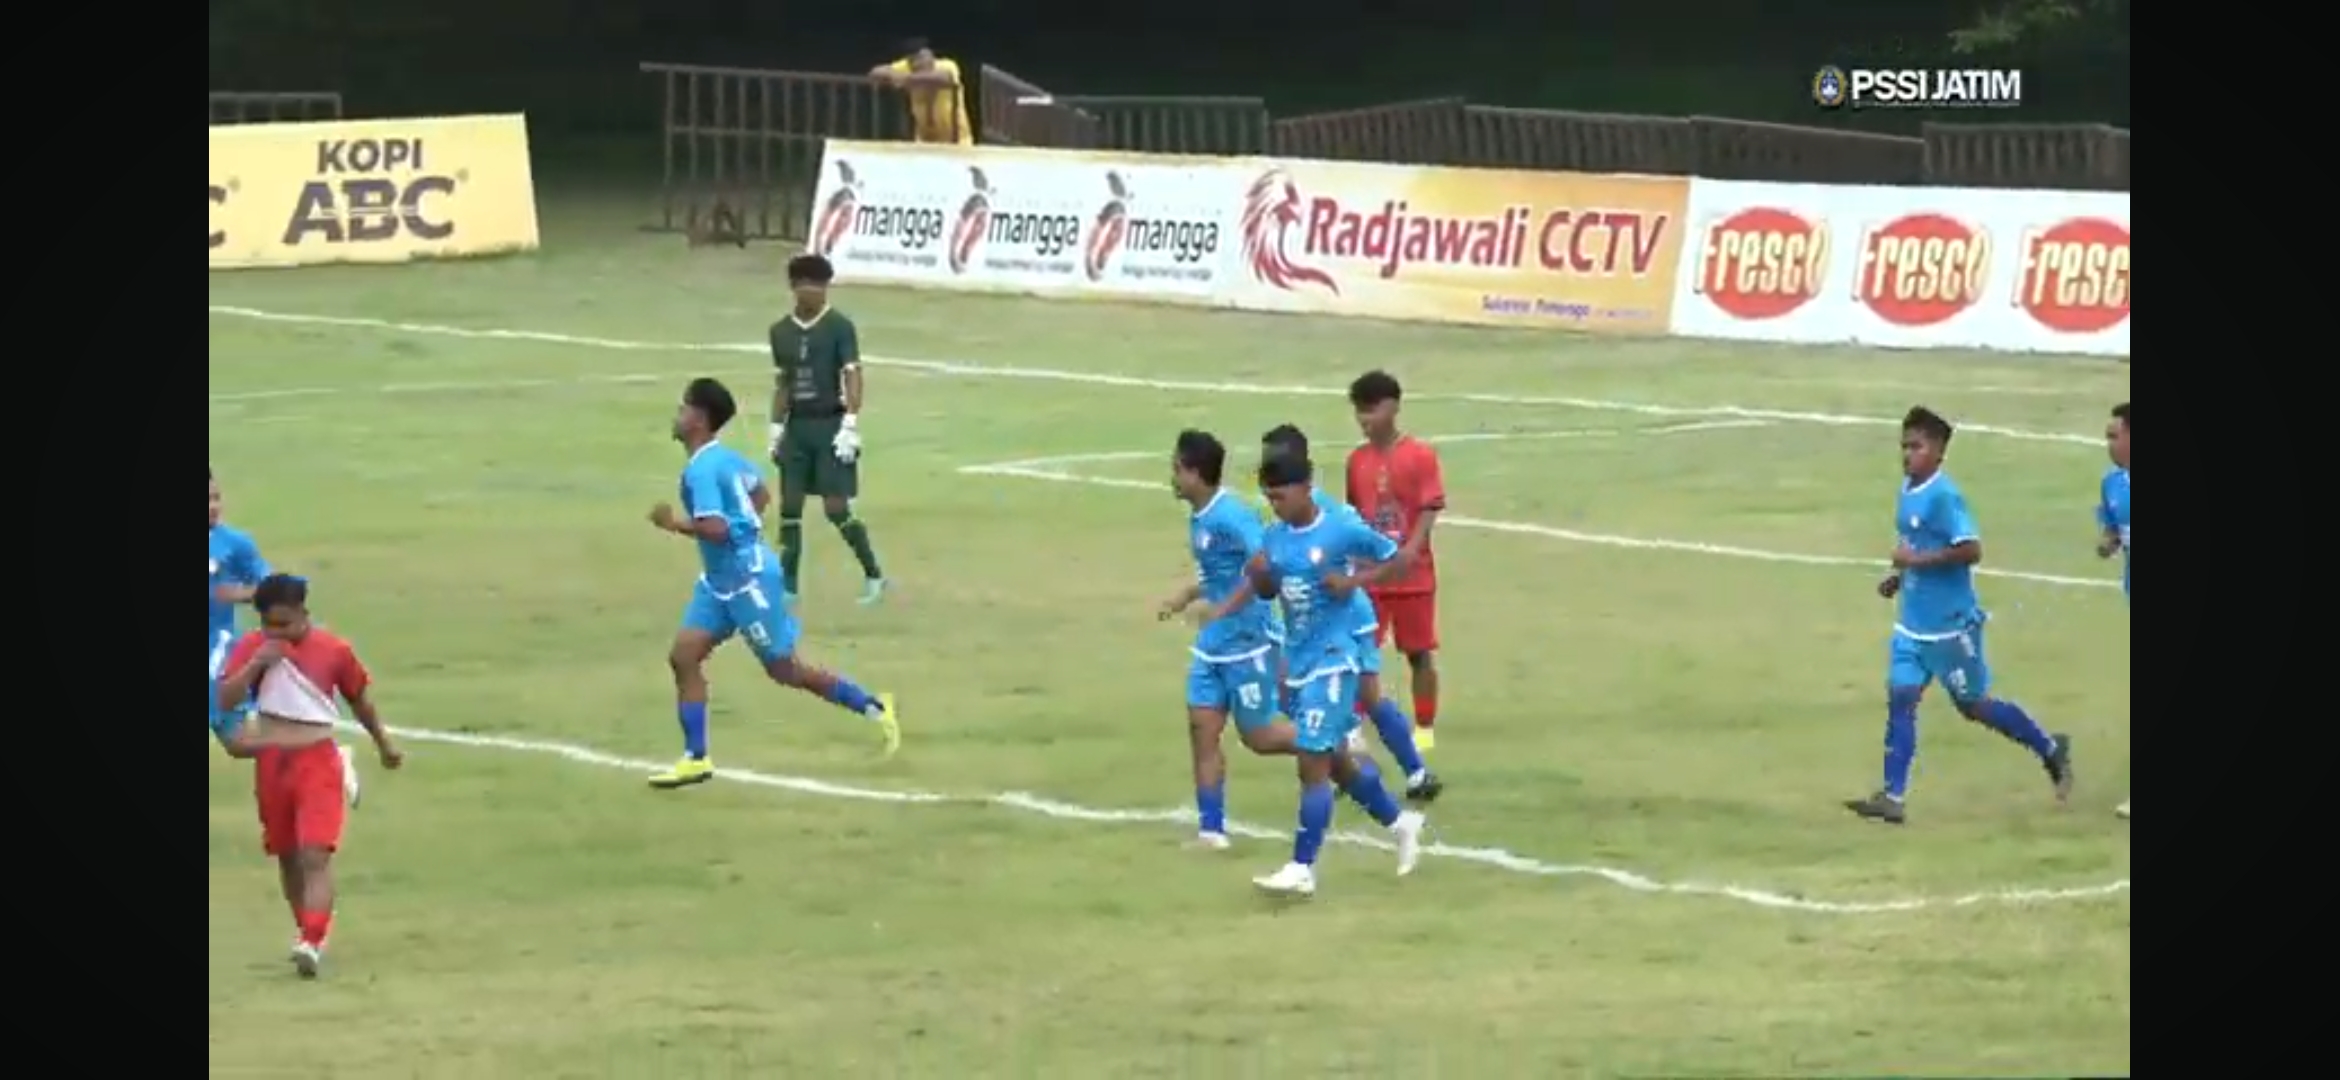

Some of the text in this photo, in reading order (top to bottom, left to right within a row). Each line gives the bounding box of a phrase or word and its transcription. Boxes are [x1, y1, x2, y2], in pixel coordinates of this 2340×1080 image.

[317, 138, 423, 173] KOPI
[282, 175, 455, 245] ABC
[854, 205, 944, 248] mangga
[988, 211, 1079, 254] mangga
[1304, 197, 1667, 279] Radjawali CCTV
[1126, 219, 1218, 262] mangga
[1693, 213, 1829, 298] Fresco
[1851, 219, 1991, 305] Fresco
